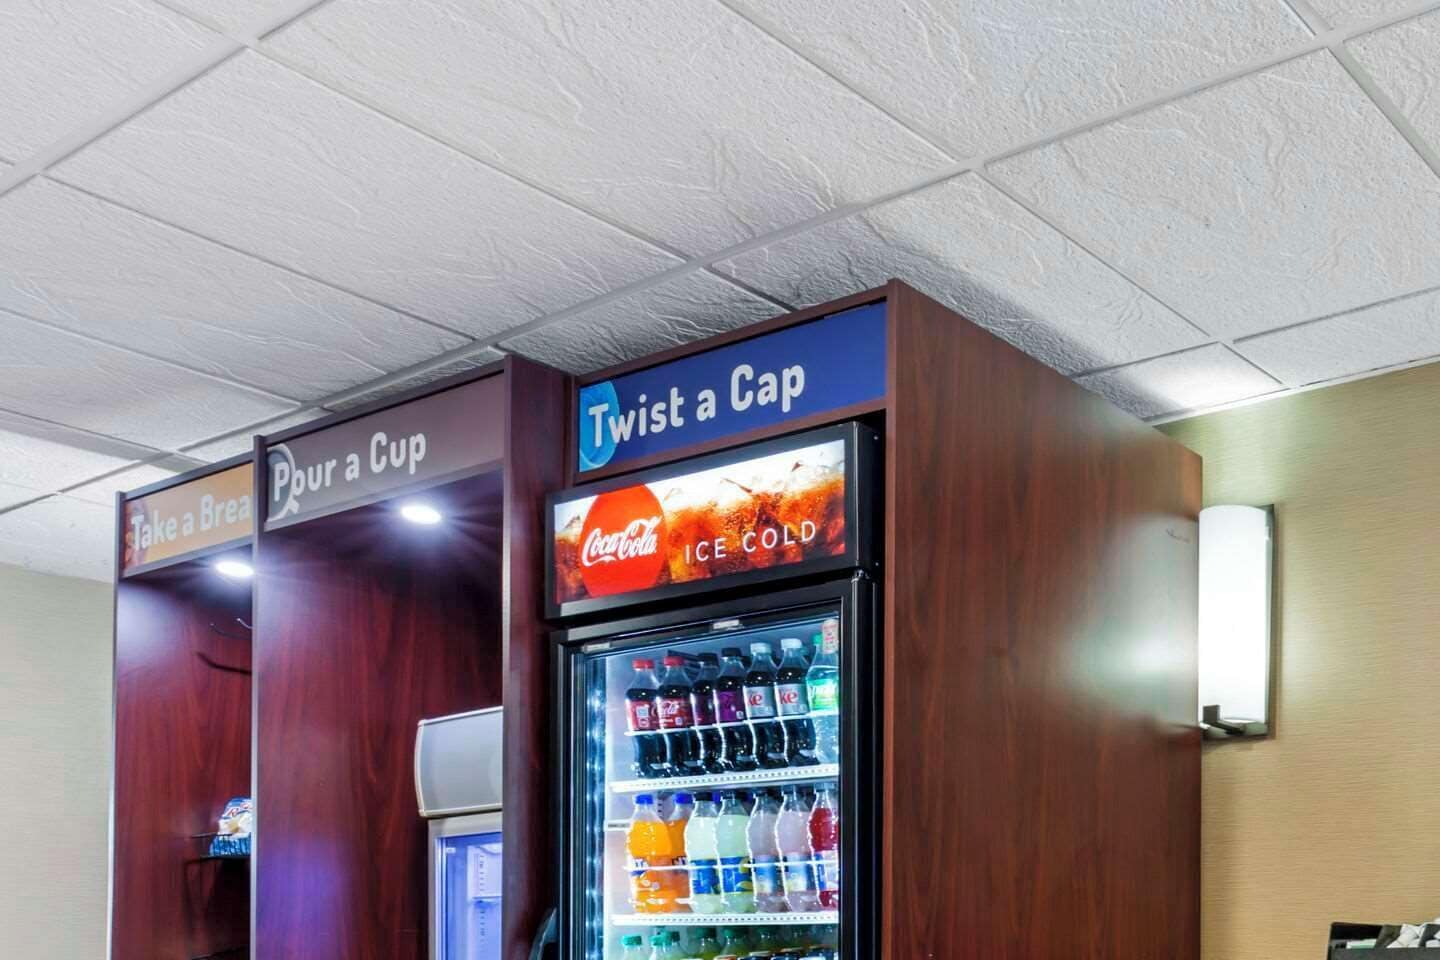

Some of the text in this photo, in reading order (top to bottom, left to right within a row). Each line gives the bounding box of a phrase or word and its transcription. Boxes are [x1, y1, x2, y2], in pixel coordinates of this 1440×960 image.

[588, 364, 806, 448] Twist a Cap
[273, 432, 427, 502] Pour a Cup
[131, 493, 251, 552] Take a Brea
[581, 515, 817, 567] Coca-Cola ICE COLD
